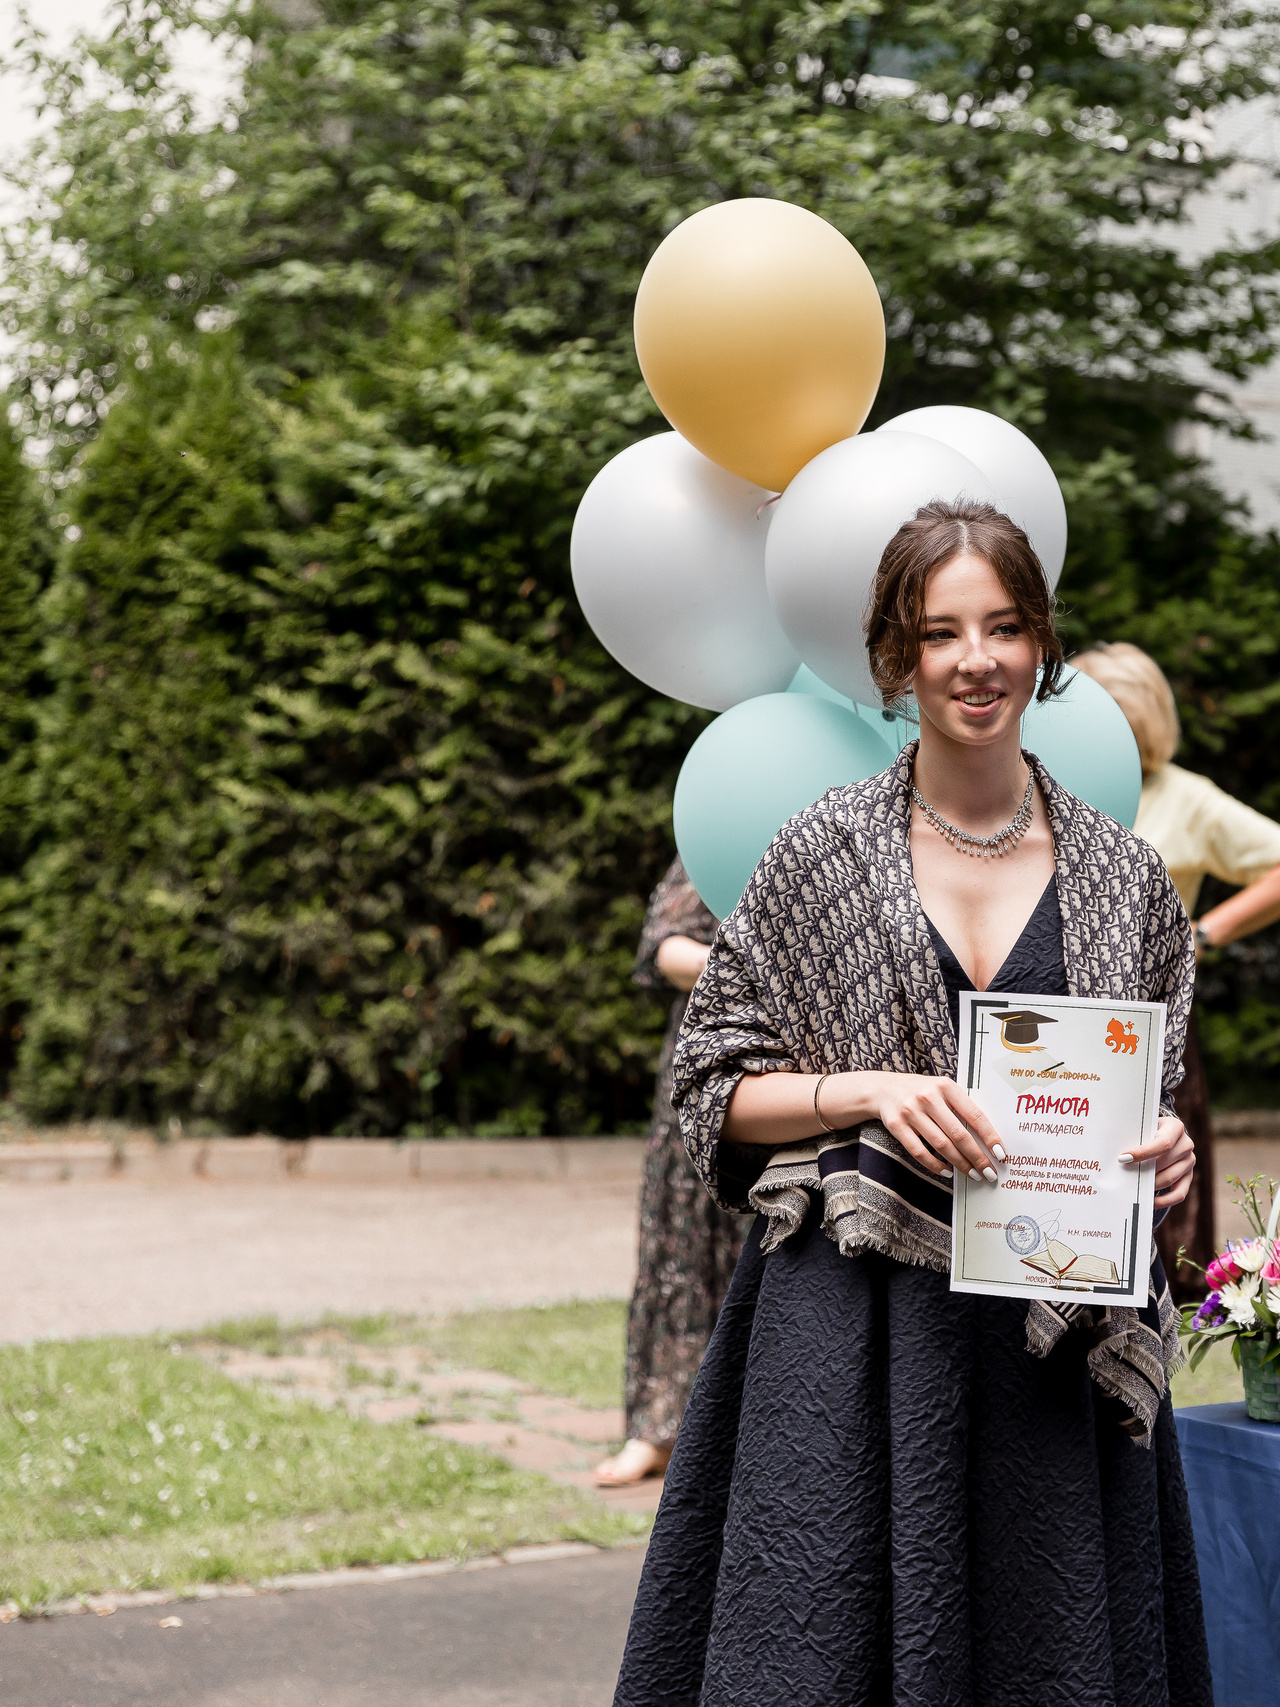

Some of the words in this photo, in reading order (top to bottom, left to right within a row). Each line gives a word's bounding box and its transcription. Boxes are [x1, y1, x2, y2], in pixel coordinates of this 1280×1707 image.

[1015, 1093, 1090, 1117] ГРАМОТА
[1018, 1122, 1085, 1137] НАГРАЖДАЕТСЯ
[999, 1154, 1047, 1168] АНДОХИНА
[1048, 1158, 1102, 1172] АНАСТАСИЯ,
[1009, 1169, 1046, 1179] ПОБЕДИТЕЛЬ
[1052, 1172, 1090, 1183] НОМИНАЦИИ
[1001, 1180, 1034, 1191] «САМАЯ
[1034, 1182, 1098, 1196] АРТИСТИЧНАЯ»
[975, 1221, 1003, 1230] ДИРЕКТОР
[1025, 1275, 1048, 1284] МОСКВА
